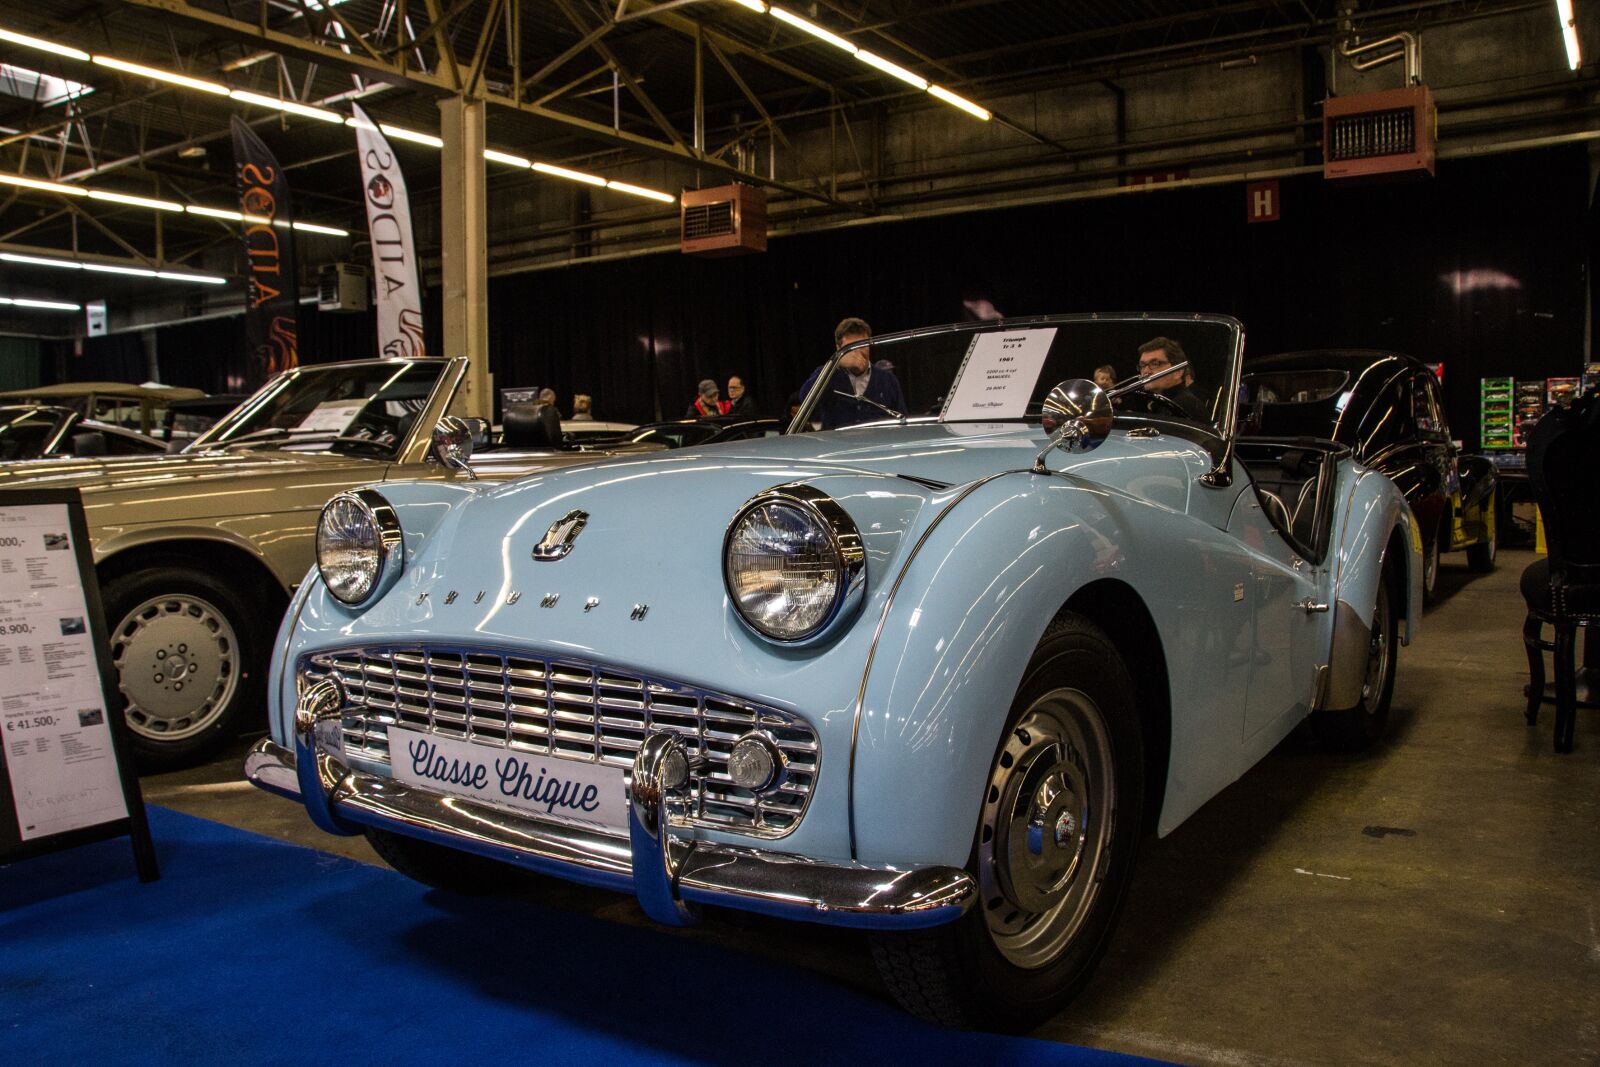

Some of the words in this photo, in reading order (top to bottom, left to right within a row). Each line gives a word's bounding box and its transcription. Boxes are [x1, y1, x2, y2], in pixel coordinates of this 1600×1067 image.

[1254, 190, 1272, 217] H
[416, 590, 649, 621] TRIUMPH
[7, 721, 15, 731] €
[17, 715, 60, 731] 41.500,-
[409, 738, 489, 790] Classe
[495, 756, 600, 814] Chique
